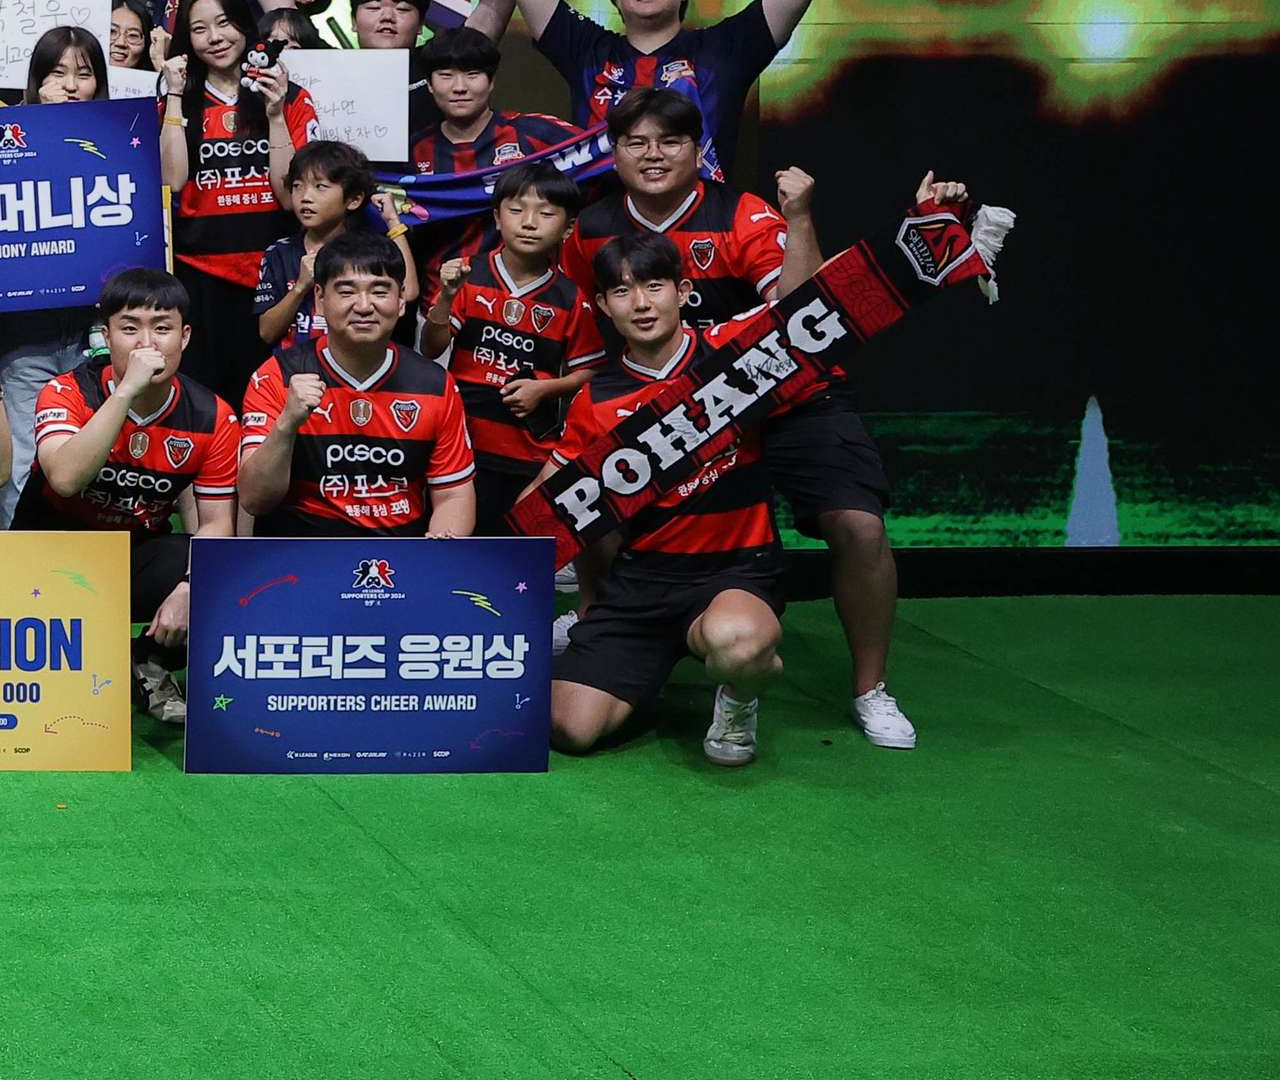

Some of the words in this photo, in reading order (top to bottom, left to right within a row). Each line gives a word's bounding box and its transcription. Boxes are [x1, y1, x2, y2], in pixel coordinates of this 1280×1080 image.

[199, 138, 271, 164] posco
[242, 192, 258, 206] 중심
[260, 191, 275, 205] 포
[30, 239, 76, 257] AWARD
[481, 324, 535, 353] posco
[554, 296, 848, 532] POHANG
[326, 443, 406, 468] posco
[96, 466, 173, 493] posco
[213, 634, 387, 680] 서포터즈
[398, 633, 530, 680] 응원상
[267, 694, 366, 712] SUPPORTERS
[370, 694, 419, 712] CHEER
[423, 694, 478, 711] AWARD
